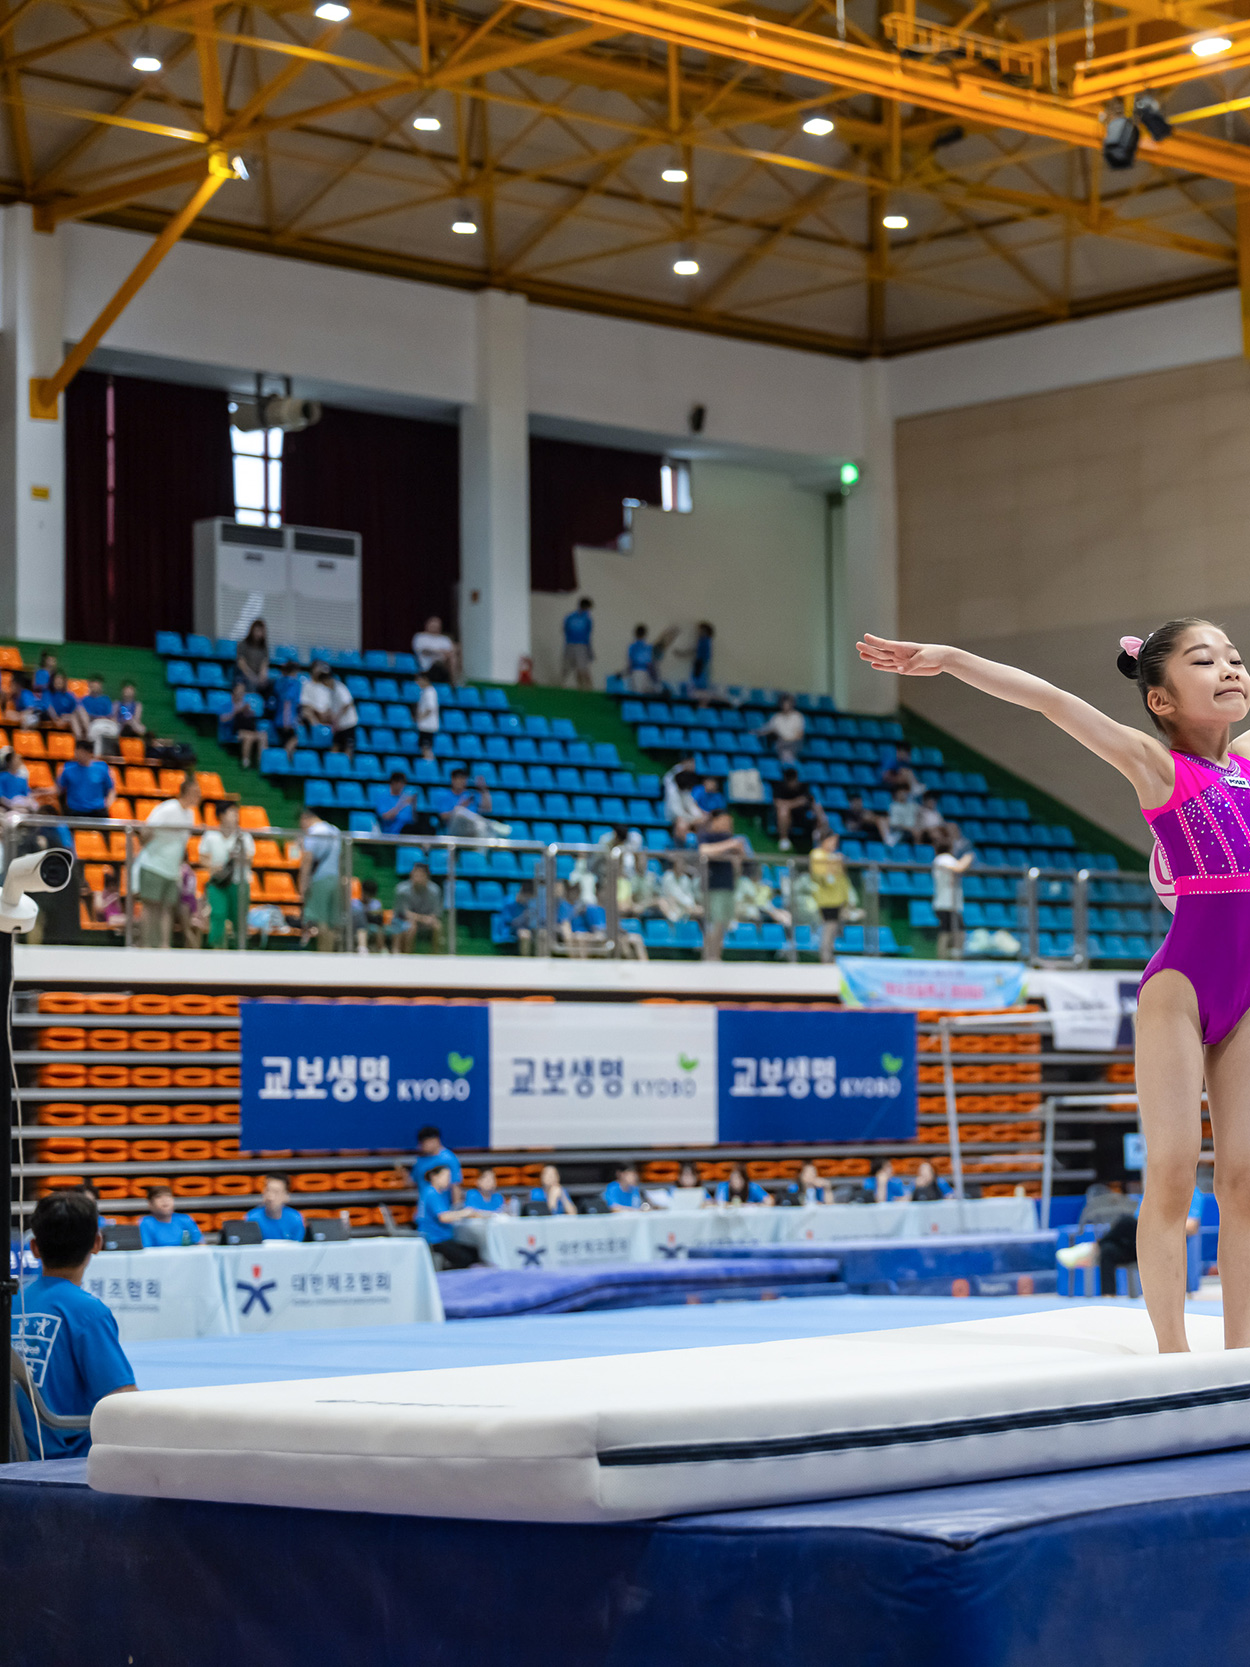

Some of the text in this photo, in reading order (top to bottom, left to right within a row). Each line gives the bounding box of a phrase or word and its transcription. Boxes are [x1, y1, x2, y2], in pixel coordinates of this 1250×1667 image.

[258, 1055, 471, 1102] 교보생명 KYOBO
[510, 1057, 698, 1099] 교보생명 KYOBO
[729, 1056, 902, 1099] 교보생명 KYOBO
